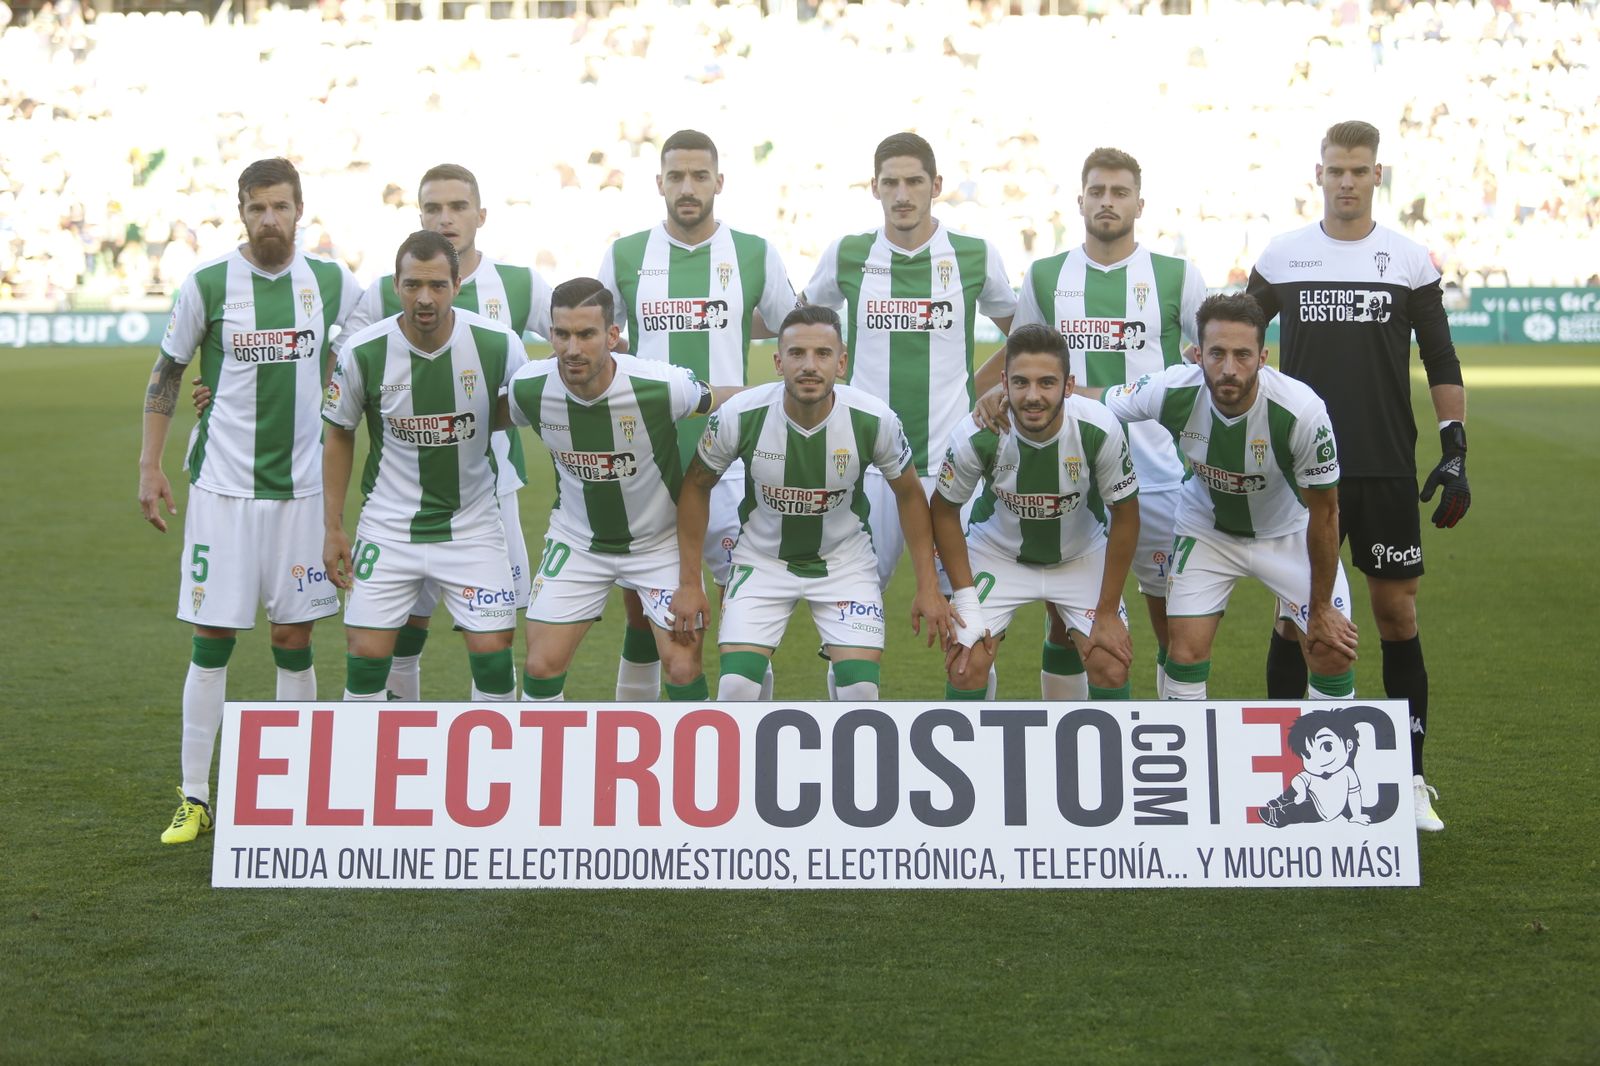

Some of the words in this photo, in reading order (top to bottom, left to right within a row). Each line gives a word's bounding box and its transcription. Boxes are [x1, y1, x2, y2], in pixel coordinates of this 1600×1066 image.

[1289, 260, 1322, 268] Kappa
[1054, 289, 1084, 297] Kappa
[1300, 290, 1353, 304] ELECTRO
[223, 302, 255, 310] Kappa
[642, 301, 692, 315] ELECTRO
[867, 301, 917, 313] ELECTRO
[1300, 305, 1346, 322] COSTO
[643, 315, 684, 331] COSTO
[867, 315, 909, 330] COSTO
[1060, 320, 1110, 333] ELECTRO
[233, 332, 283, 347] ELECTRO
[234, 346, 276, 362] COSTO
[379, 384, 412, 392] Kappa
[387, 417, 439, 430] ELECTRO
[539, 422, 570, 431] Kappa
[391, 428, 432, 445] COSTO
[1180, 431, 1208, 443] Kappa
[753, 450, 786, 460] Kappa
[762, 484, 813, 501] ELECTRO
[762, 494, 803, 514] COSTO
[1386, 545, 1421, 563] forte
[191, 543, 210, 583] 5
[307, 567, 329, 584] for
[477, 588, 515, 605] forte
[480, 609, 513, 618] Kappa
[231, 847, 328, 879] TIENDA
[338, 847, 435, 879] ONLINE
[445, 848, 479, 879] DE
[489, 842, 797, 883] ELECTRODOMÉSTICOS,
[808, 841, 1004, 883] ELECTRÓNICA,
[1014, 841, 1187, 879] TELEFONÍA...
[1197, 847, 1214, 878] Y
[1225, 846, 1322, 878] MUCHO
[1331, 840, 1400, 878] MÁS!
